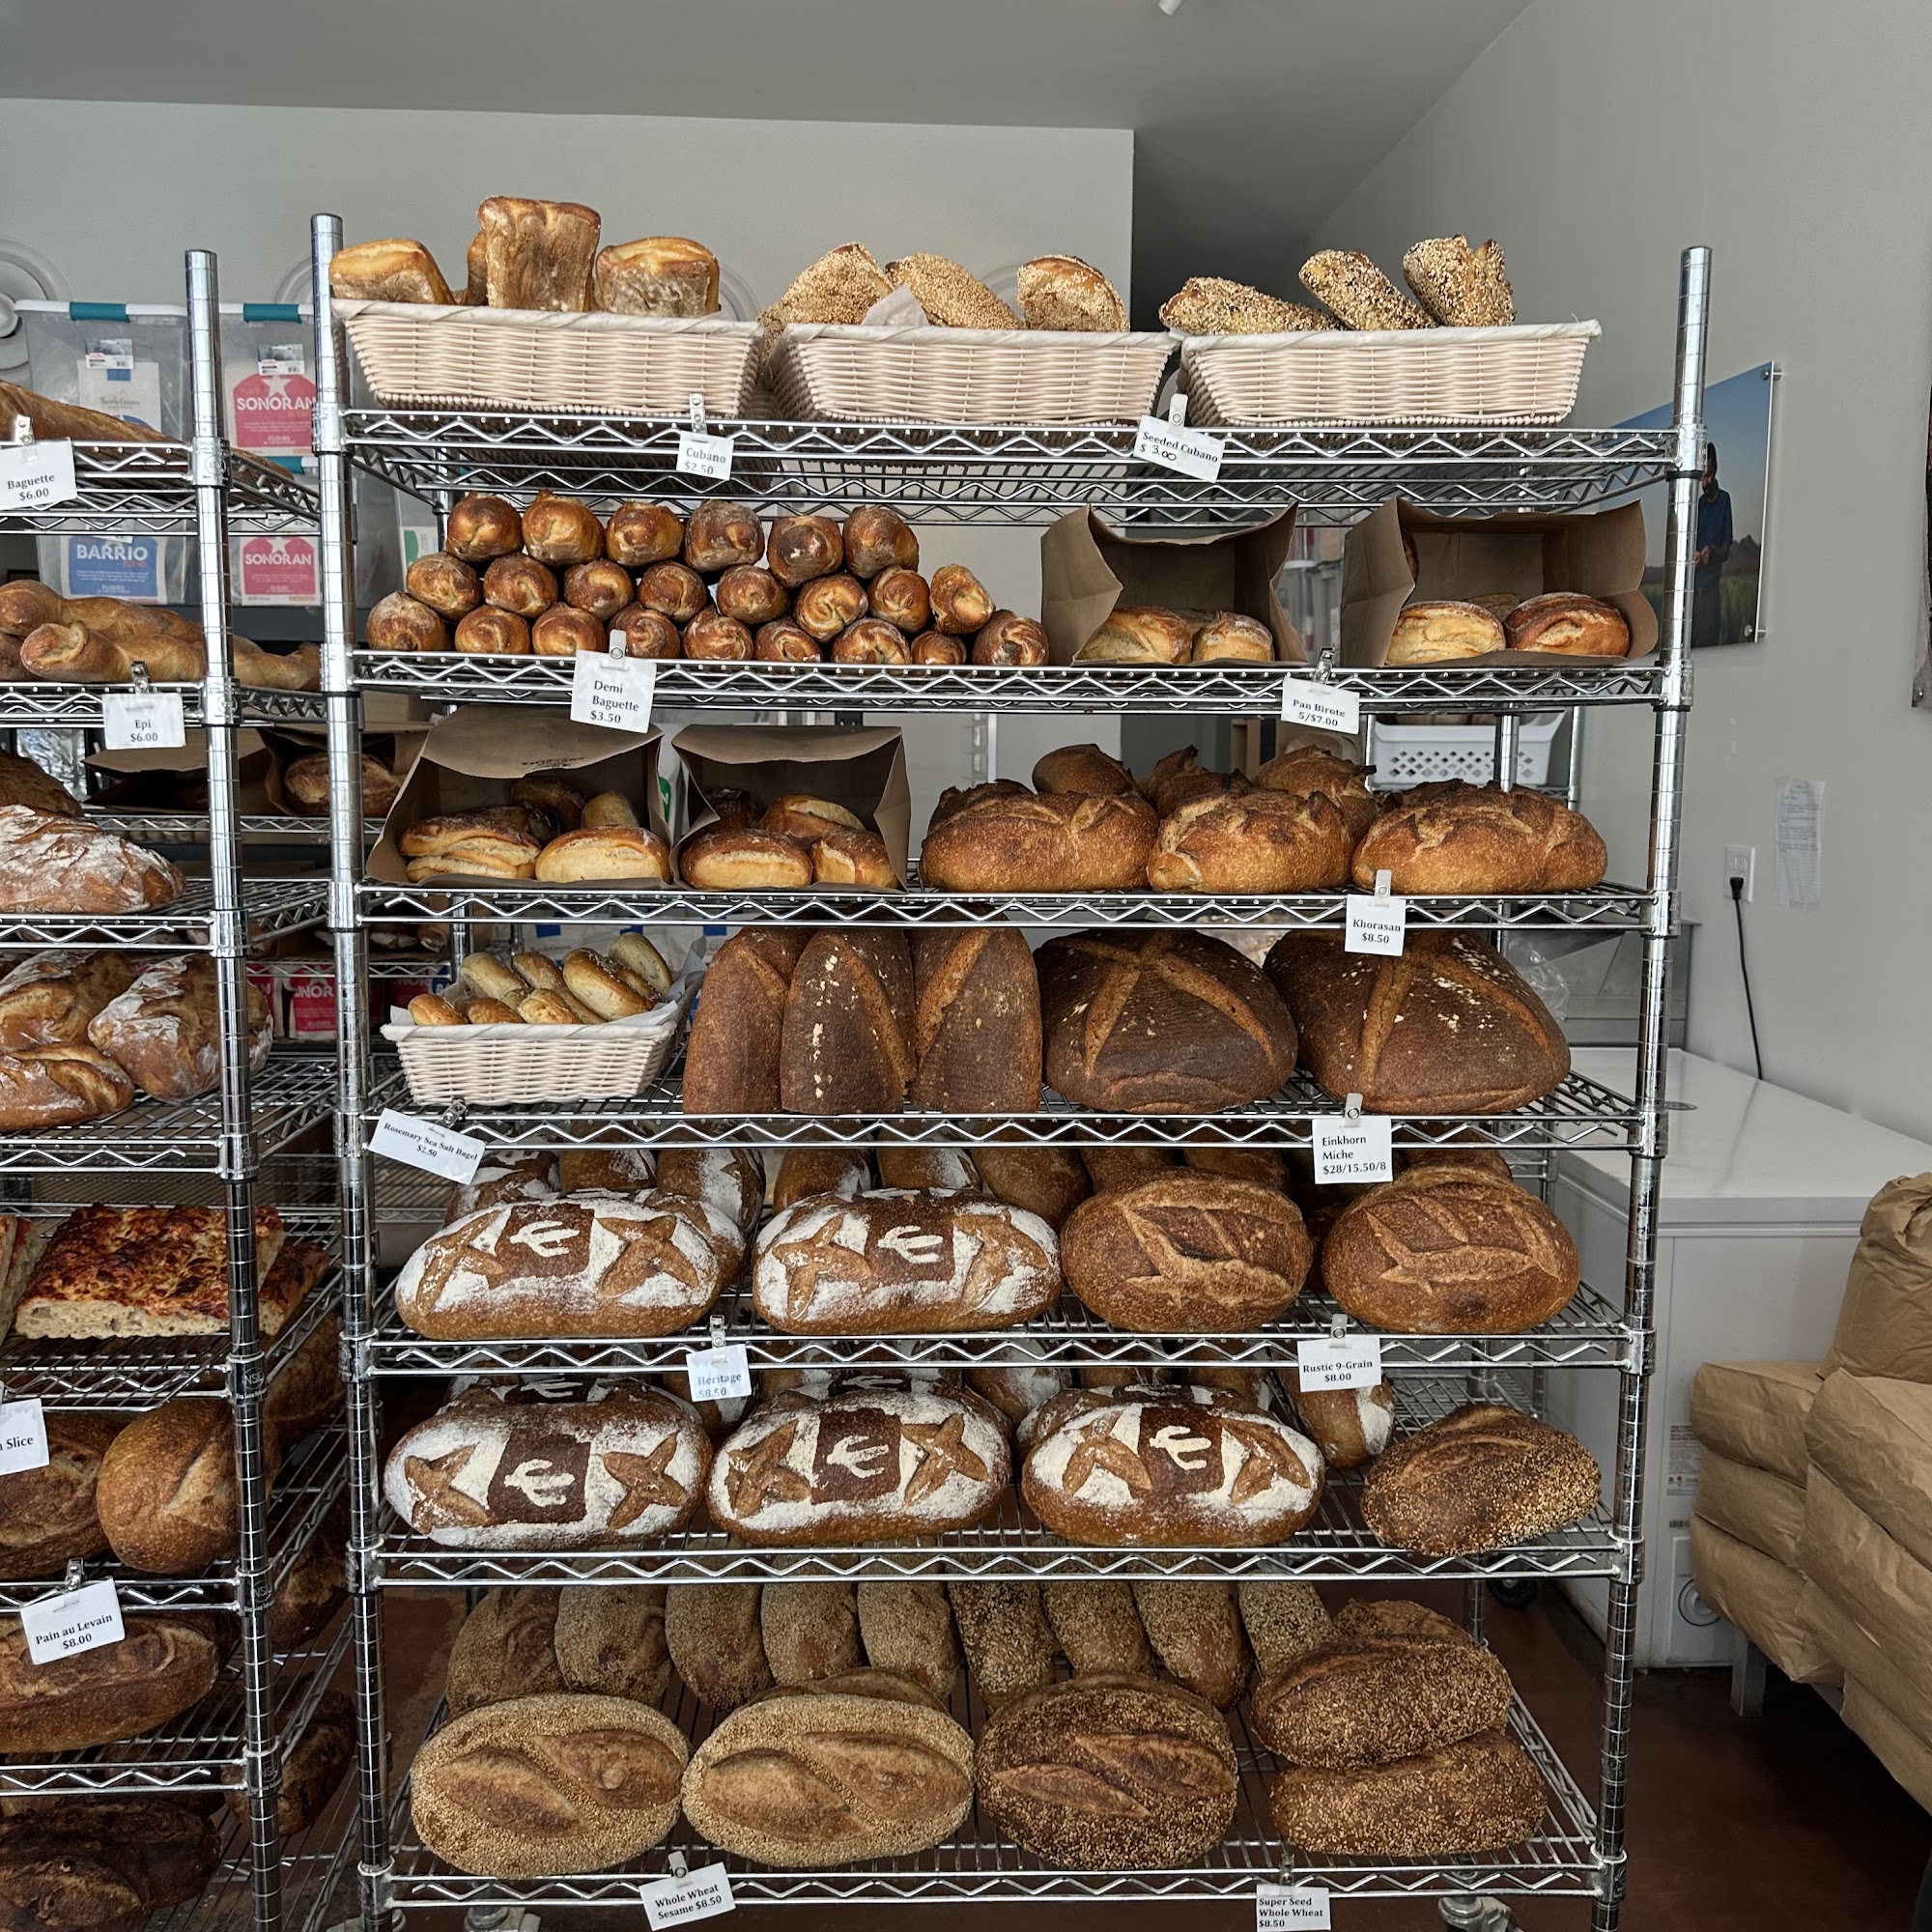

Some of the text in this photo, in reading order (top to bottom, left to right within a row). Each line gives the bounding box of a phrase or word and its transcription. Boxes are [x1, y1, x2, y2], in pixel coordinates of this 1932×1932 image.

[1142, 431, 1218, 463] Seeded Cubano
[686, 447, 726, 464] Cubano
[684, 461, 714, 475] $2.50
[7, 474, 55, 490] Baguette
[19, 488, 49, 501] $6.00
[76, 544, 149, 561] BARRIO
[244, 554, 312, 565] SONORAN
[594, 680, 624, 694] Demi
[592, 695, 639, 712] Baguette
[1293, 698, 1346, 718] Pan Birote
[590, 710, 621, 724] $3.50
[1298, 711, 1338, 726] 5/$7.00
[135, 719, 152, 731] Epi
[130, 732, 158, 743] $6.00
[1352, 919, 1401, 932] Khorasan
[1362, 932, 1390, 944] $8.50
[384, 1122, 478, 1161] Rosemary Sea Salt Bagel
[1321, 1135, 1367, 1147] Einkhorn
[415, 1145, 438, 1157] $2.50
[1322, 1150, 1354, 1160] Miche
[1322, 1161, 1387, 1176] $28/15.50/8
[1303, 1359, 1373, 1373] Rustic 9-Grain
[697, 1374, 742, 1386] Heritage
[1323, 1373, 1351, 1382] $8.00
[6, 1435, 34, 1450] Slice
[36, 1614, 113, 1645] Pain au Levain
[62, 1633, 93, 1650] $8.00
[655, 1884, 719, 1908] Whole Wheat
[1259, 1897, 1312, 1908] Super Seed
[658, 1894, 723, 1920] Sesame $8.50
[1259, 1919, 1286, 1928] $8.50
